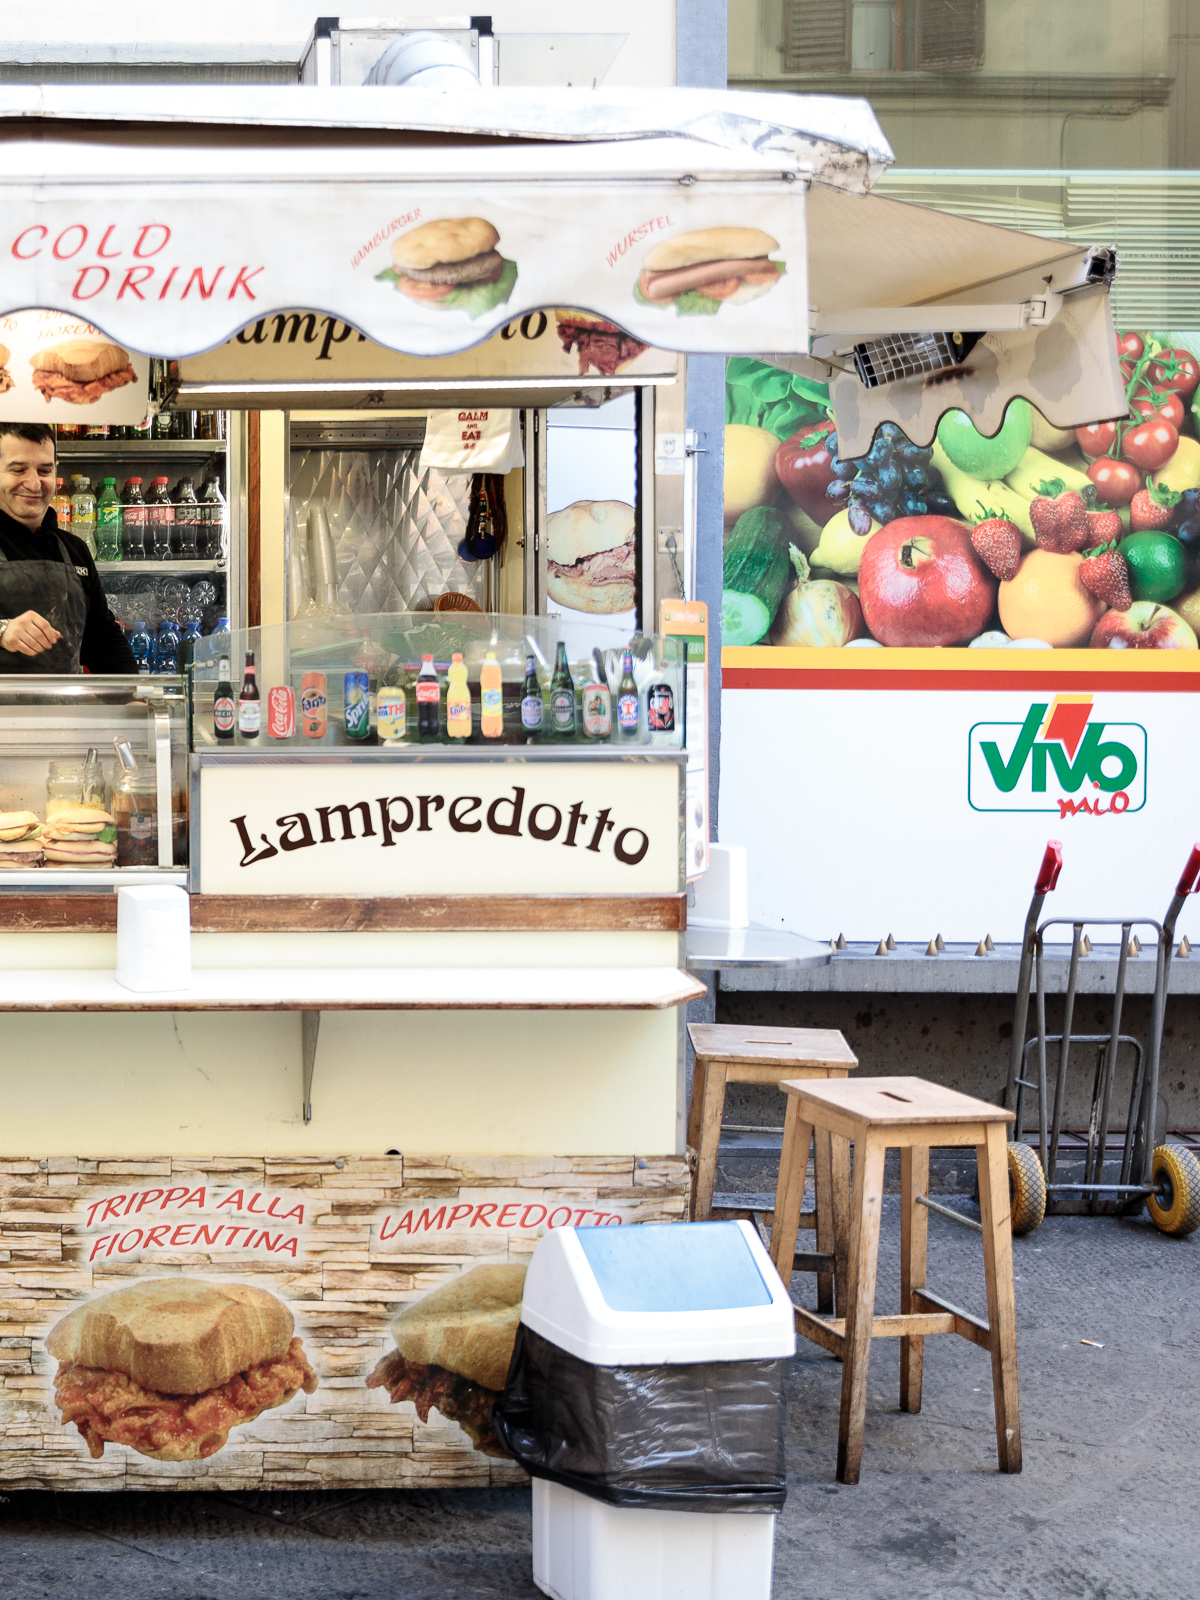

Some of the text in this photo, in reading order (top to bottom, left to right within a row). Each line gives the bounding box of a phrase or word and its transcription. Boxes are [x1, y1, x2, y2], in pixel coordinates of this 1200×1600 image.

[11, 223, 171, 260] COLD
[350, 207, 423, 270] HAMBURGER
[605, 214, 675, 268] WURSTEL
[71, 265, 265, 301] DRINK
[461, 430, 481, 440] EAT
[229, 786, 650, 867] Lampredotto
[85, 1185, 306, 1229] TRIPPA ALLA
[87, 1223, 300, 1263] FIORENTINA
